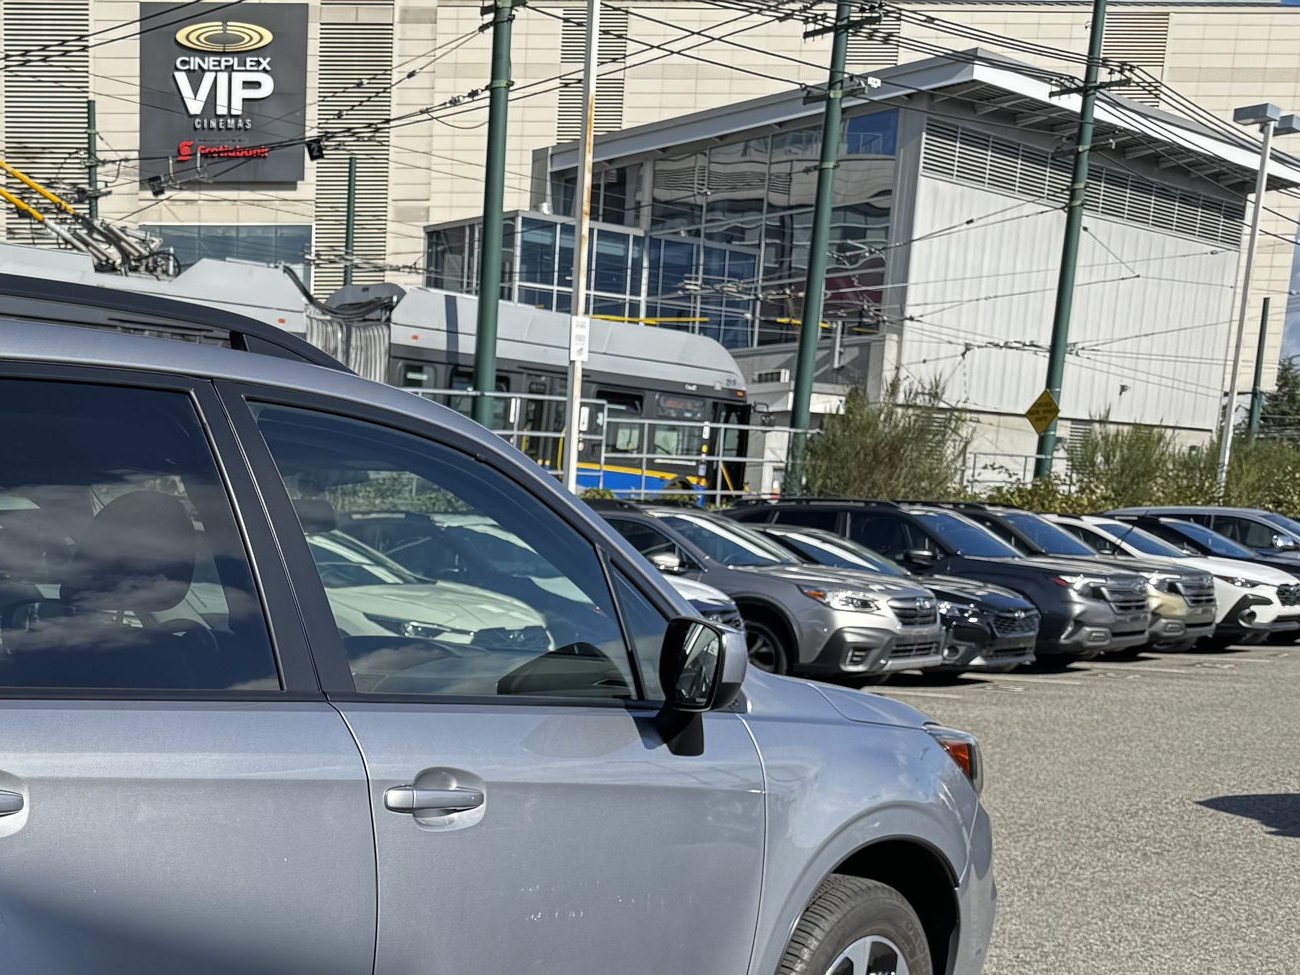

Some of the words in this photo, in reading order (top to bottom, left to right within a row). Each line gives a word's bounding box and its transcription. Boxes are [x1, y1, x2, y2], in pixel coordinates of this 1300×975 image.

[176, 56, 271, 71] CINEPLEX
[173, 71, 275, 115] VIP
[194, 118, 252, 129] CINEMAS
